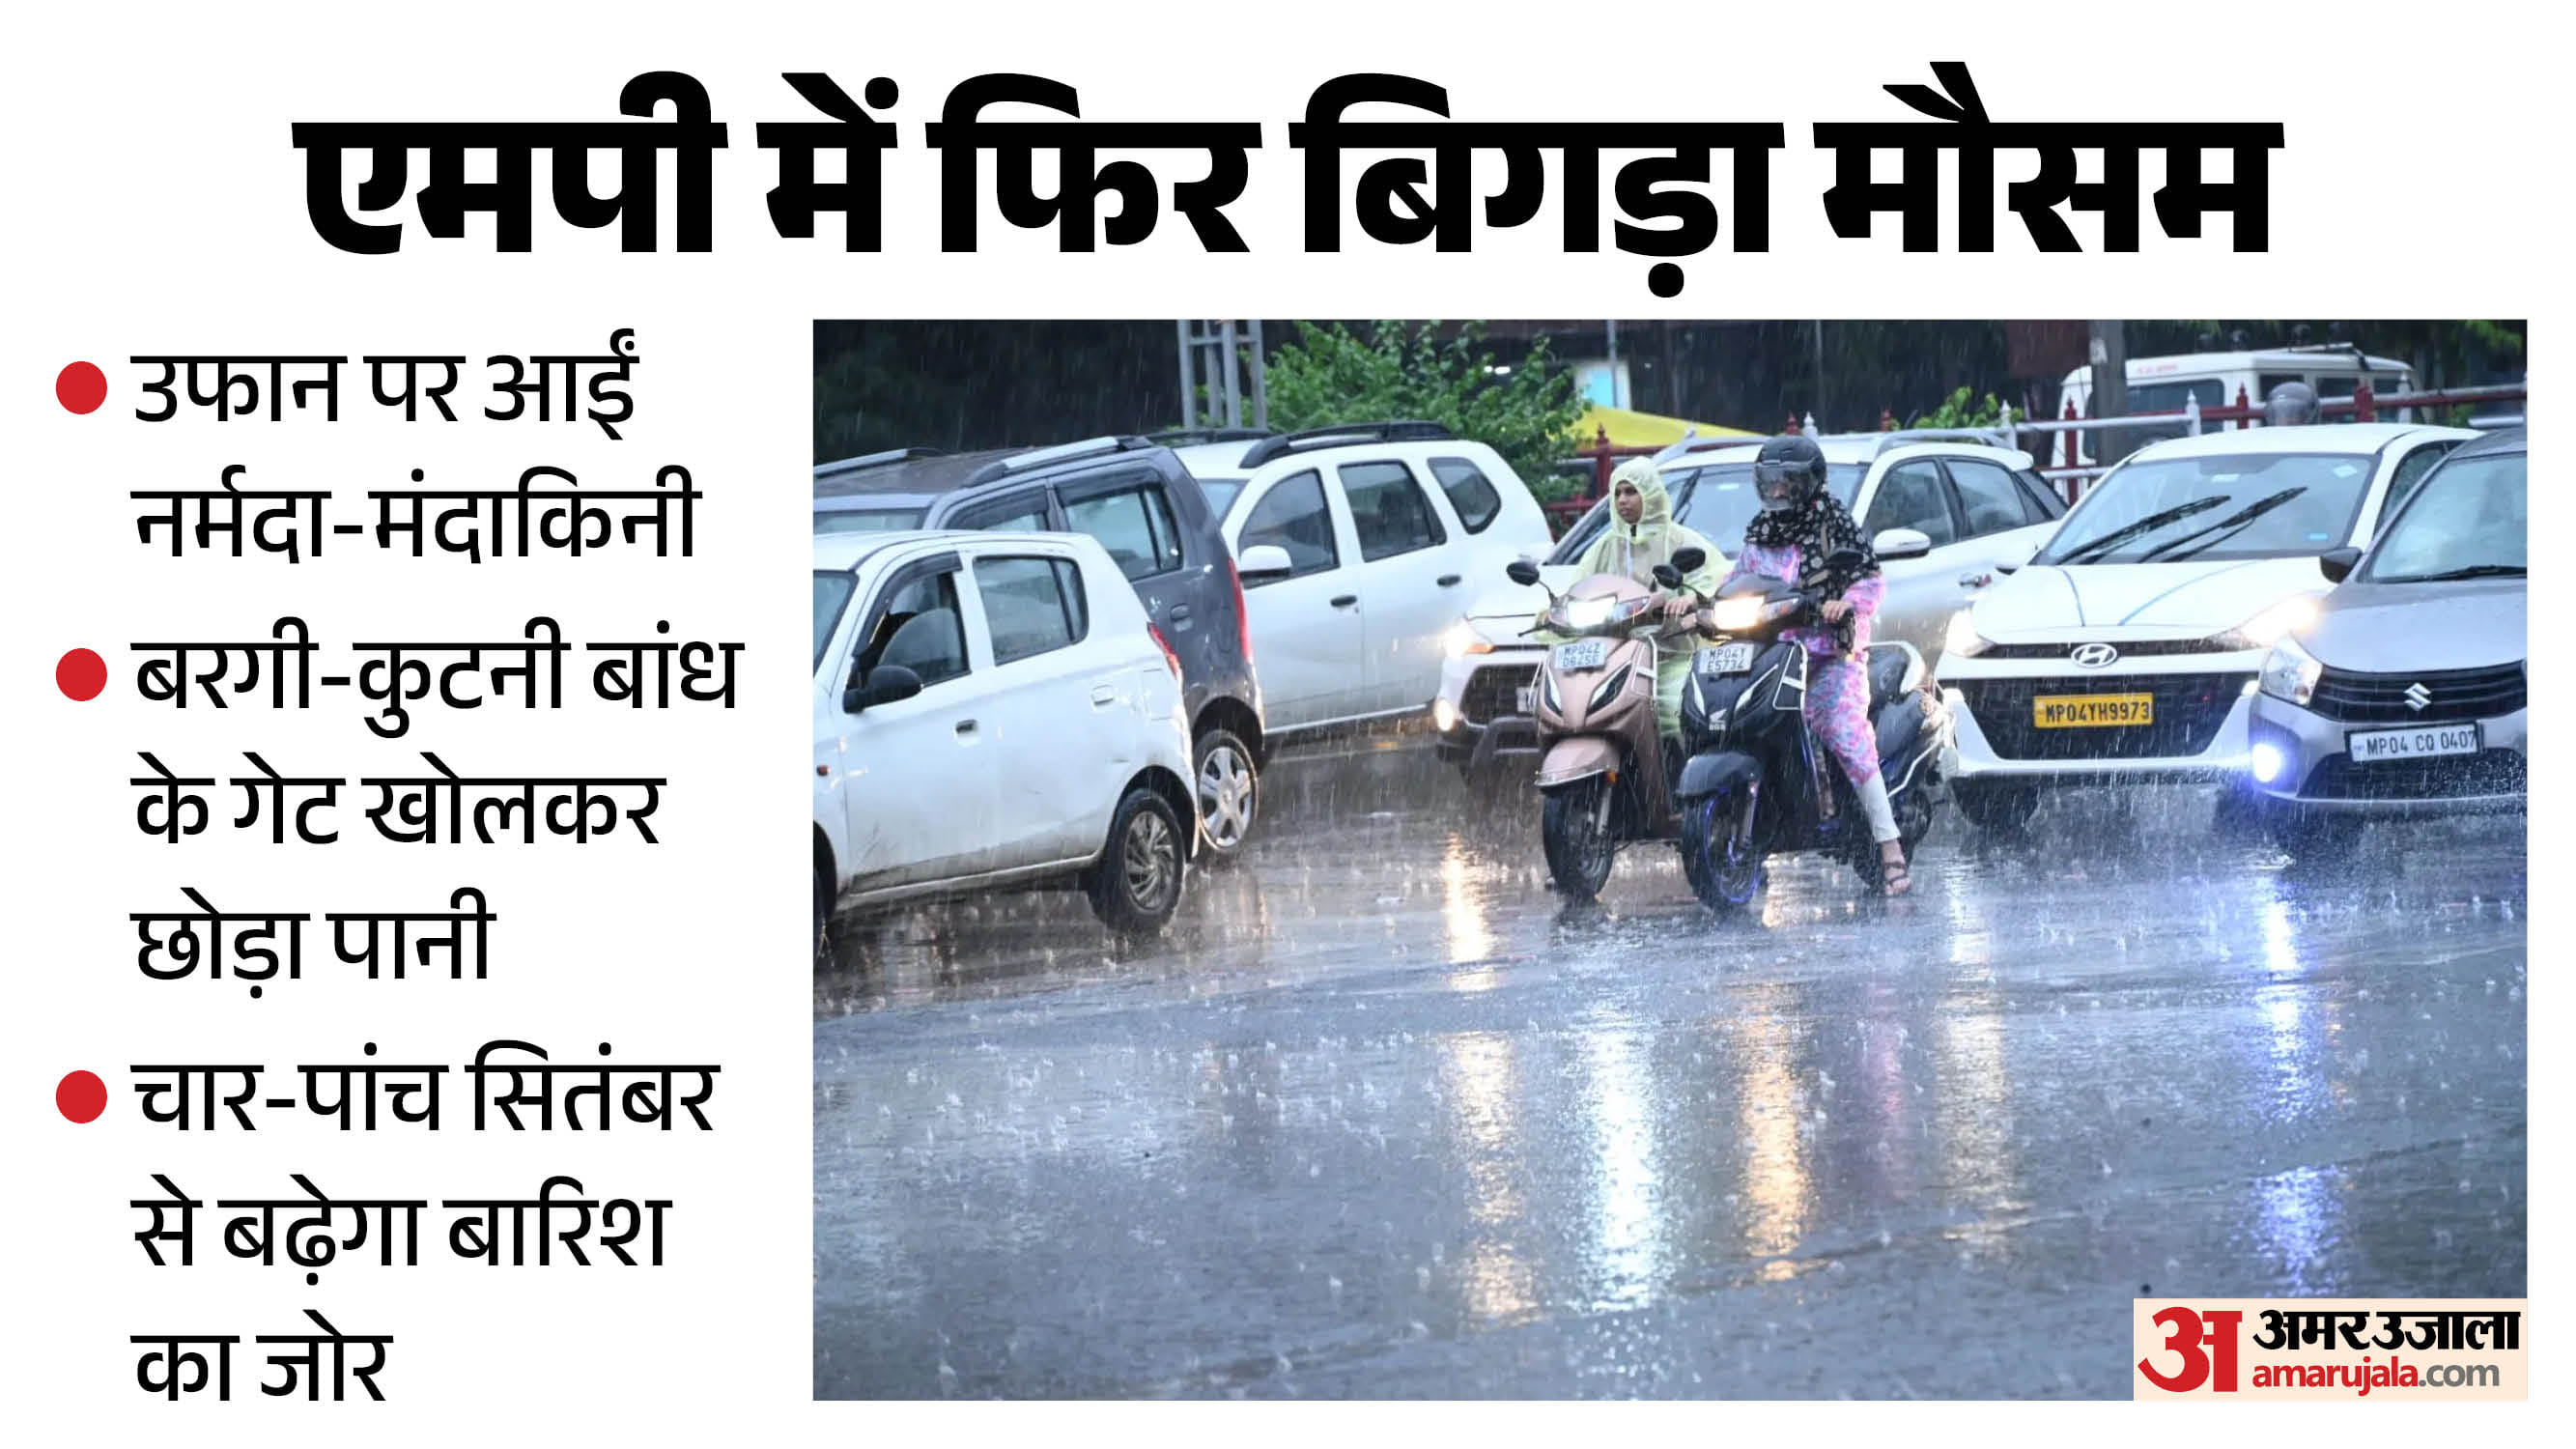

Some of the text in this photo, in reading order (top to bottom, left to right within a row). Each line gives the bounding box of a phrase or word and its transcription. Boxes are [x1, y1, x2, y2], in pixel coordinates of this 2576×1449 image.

[2045, 701, 2150, 724] MP04YH9973
[2366, 735, 2409, 756] MP04
[2440, 730, 2476, 749] 0407
